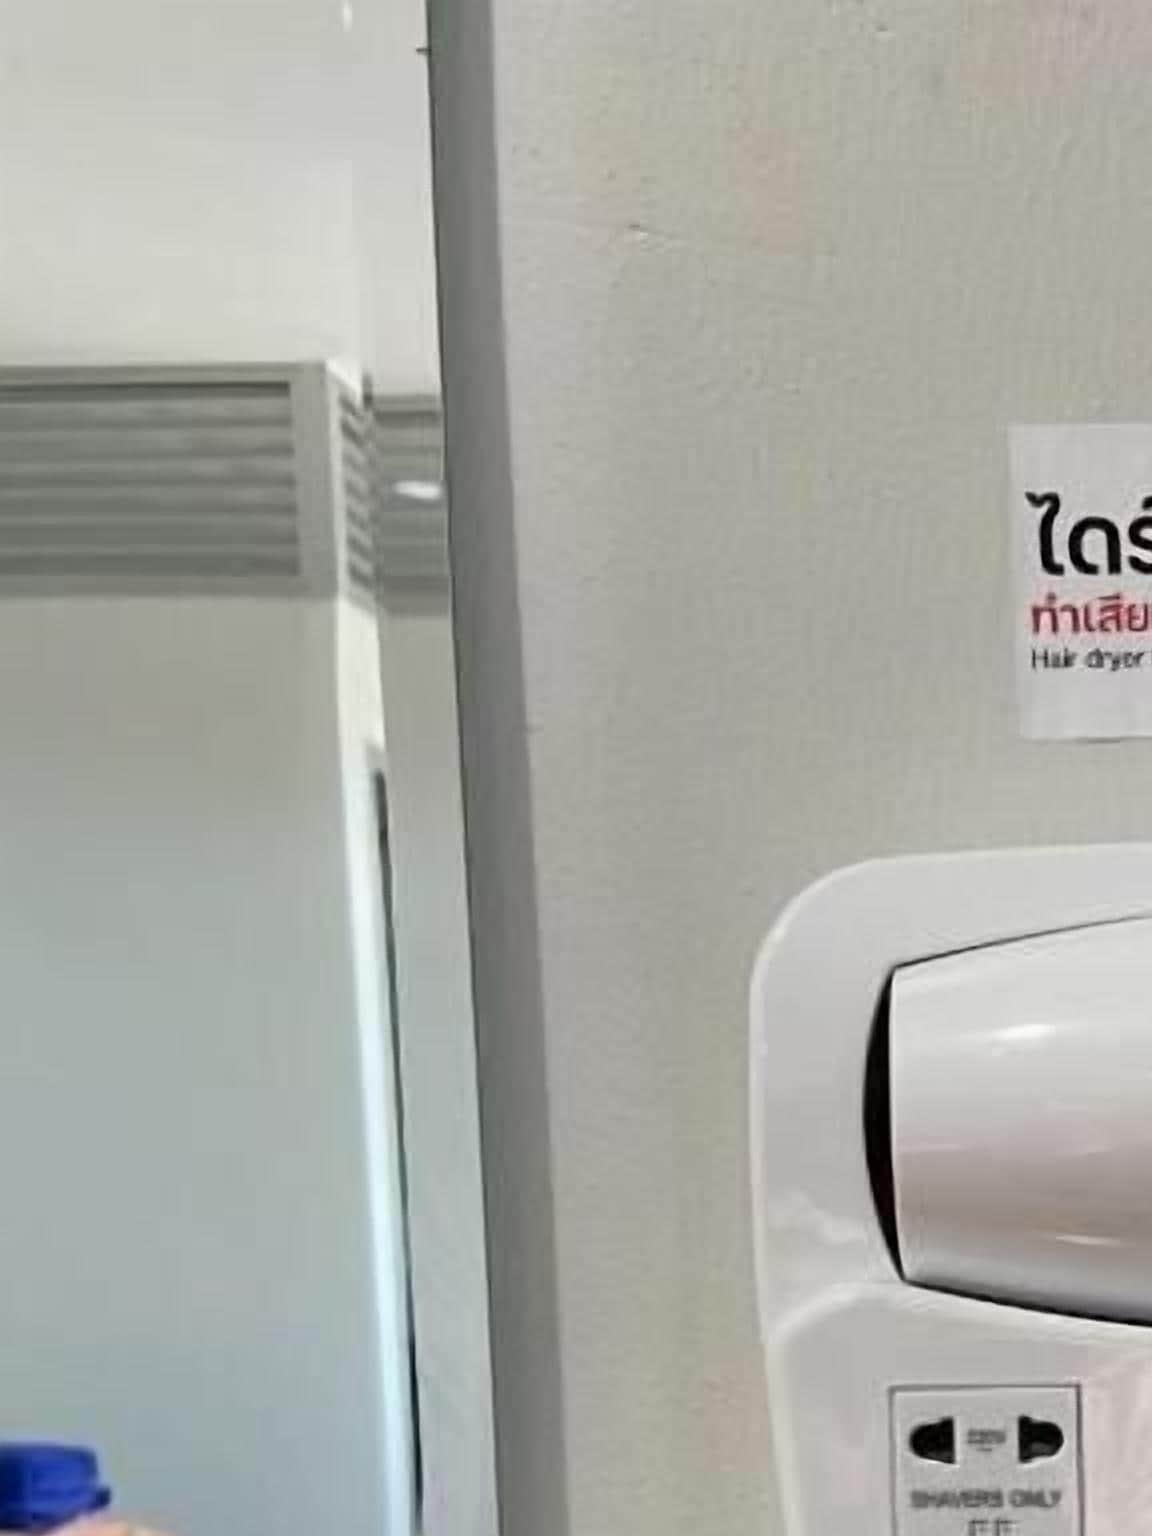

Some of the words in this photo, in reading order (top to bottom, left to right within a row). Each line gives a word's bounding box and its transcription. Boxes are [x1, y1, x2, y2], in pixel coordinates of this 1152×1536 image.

[1031, 646, 1077, 669] Hair
[1086, 648, 1144, 672] dryer
[910, 1488, 1004, 1509] SHAVERS
[1008, 1488, 1062, 1509] ONLY
